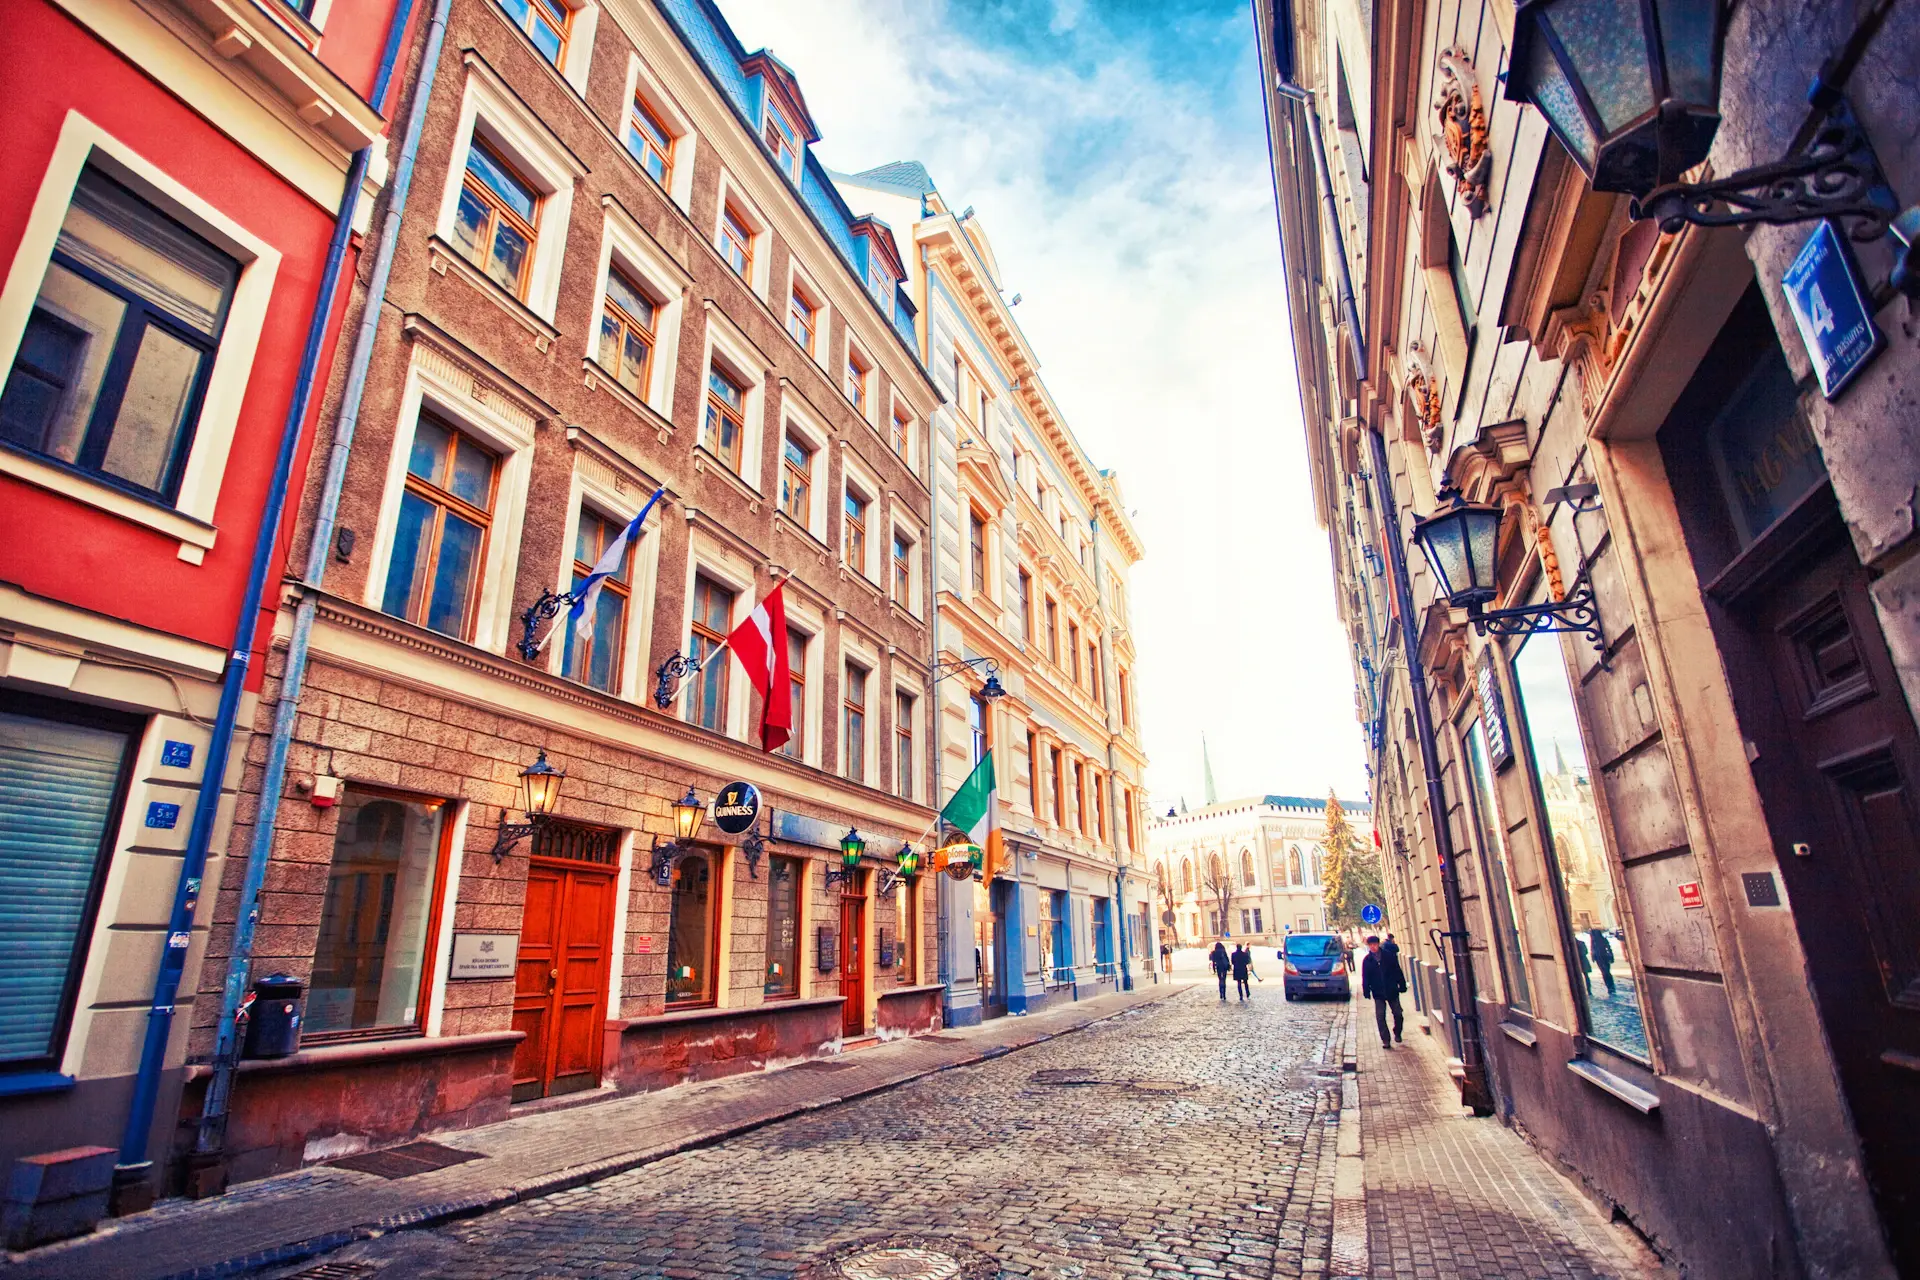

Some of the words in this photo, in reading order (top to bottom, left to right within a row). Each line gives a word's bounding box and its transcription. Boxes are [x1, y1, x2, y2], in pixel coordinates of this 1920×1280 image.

[1808, 281, 1836, 338] 4
[715, 805, 754, 818] GUINNESS
[662, 866, 669, 878] 3
